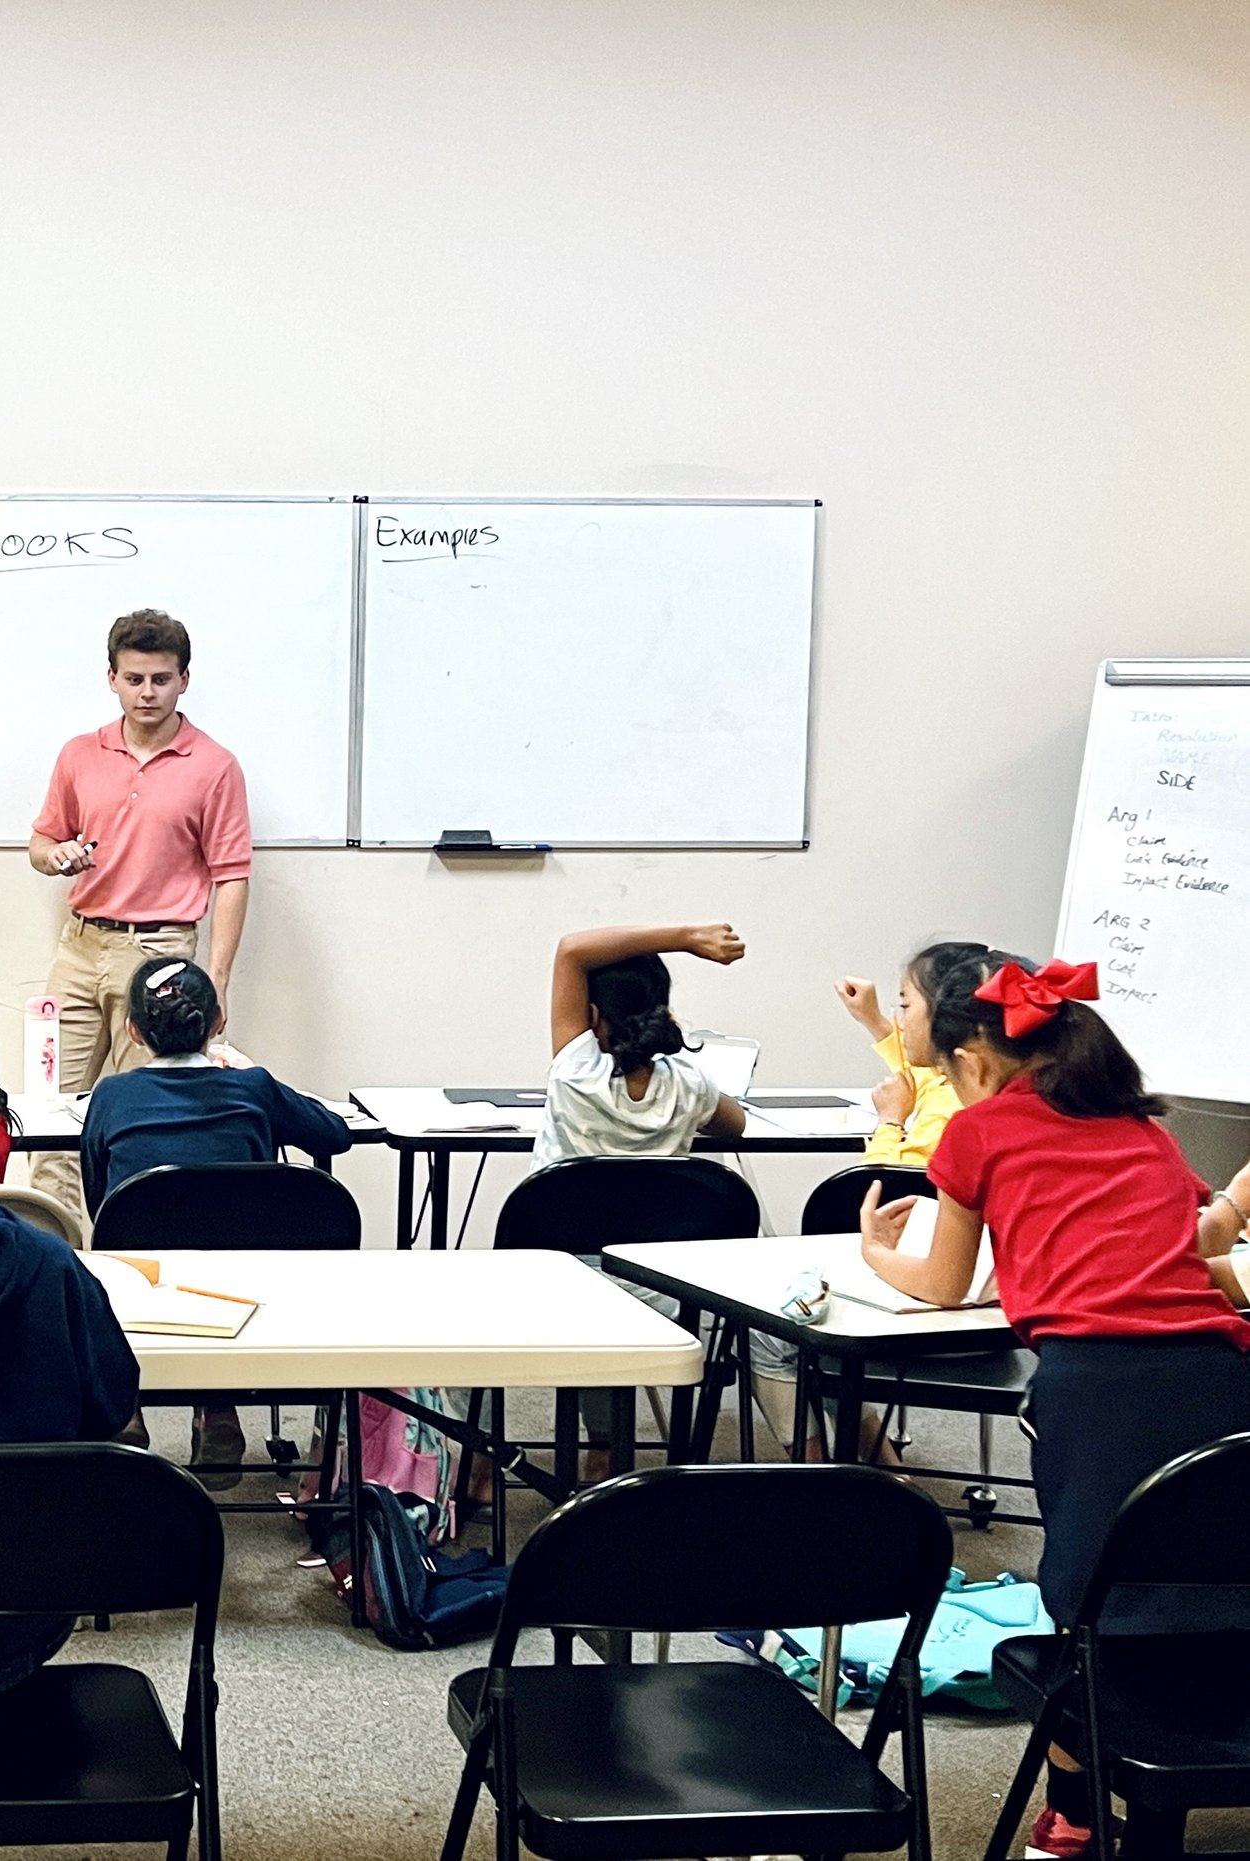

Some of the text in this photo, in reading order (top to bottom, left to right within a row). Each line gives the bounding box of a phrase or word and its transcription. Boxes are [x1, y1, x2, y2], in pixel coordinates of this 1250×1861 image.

[376, 516, 499, 559] Examples
[1156, 769, 1197, 791] SIDE
[1107, 806, 1139, 831] Arg
[1175, 873, 1230, 895] Evidence
[1092, 909, 1151, 931] ARG 2
